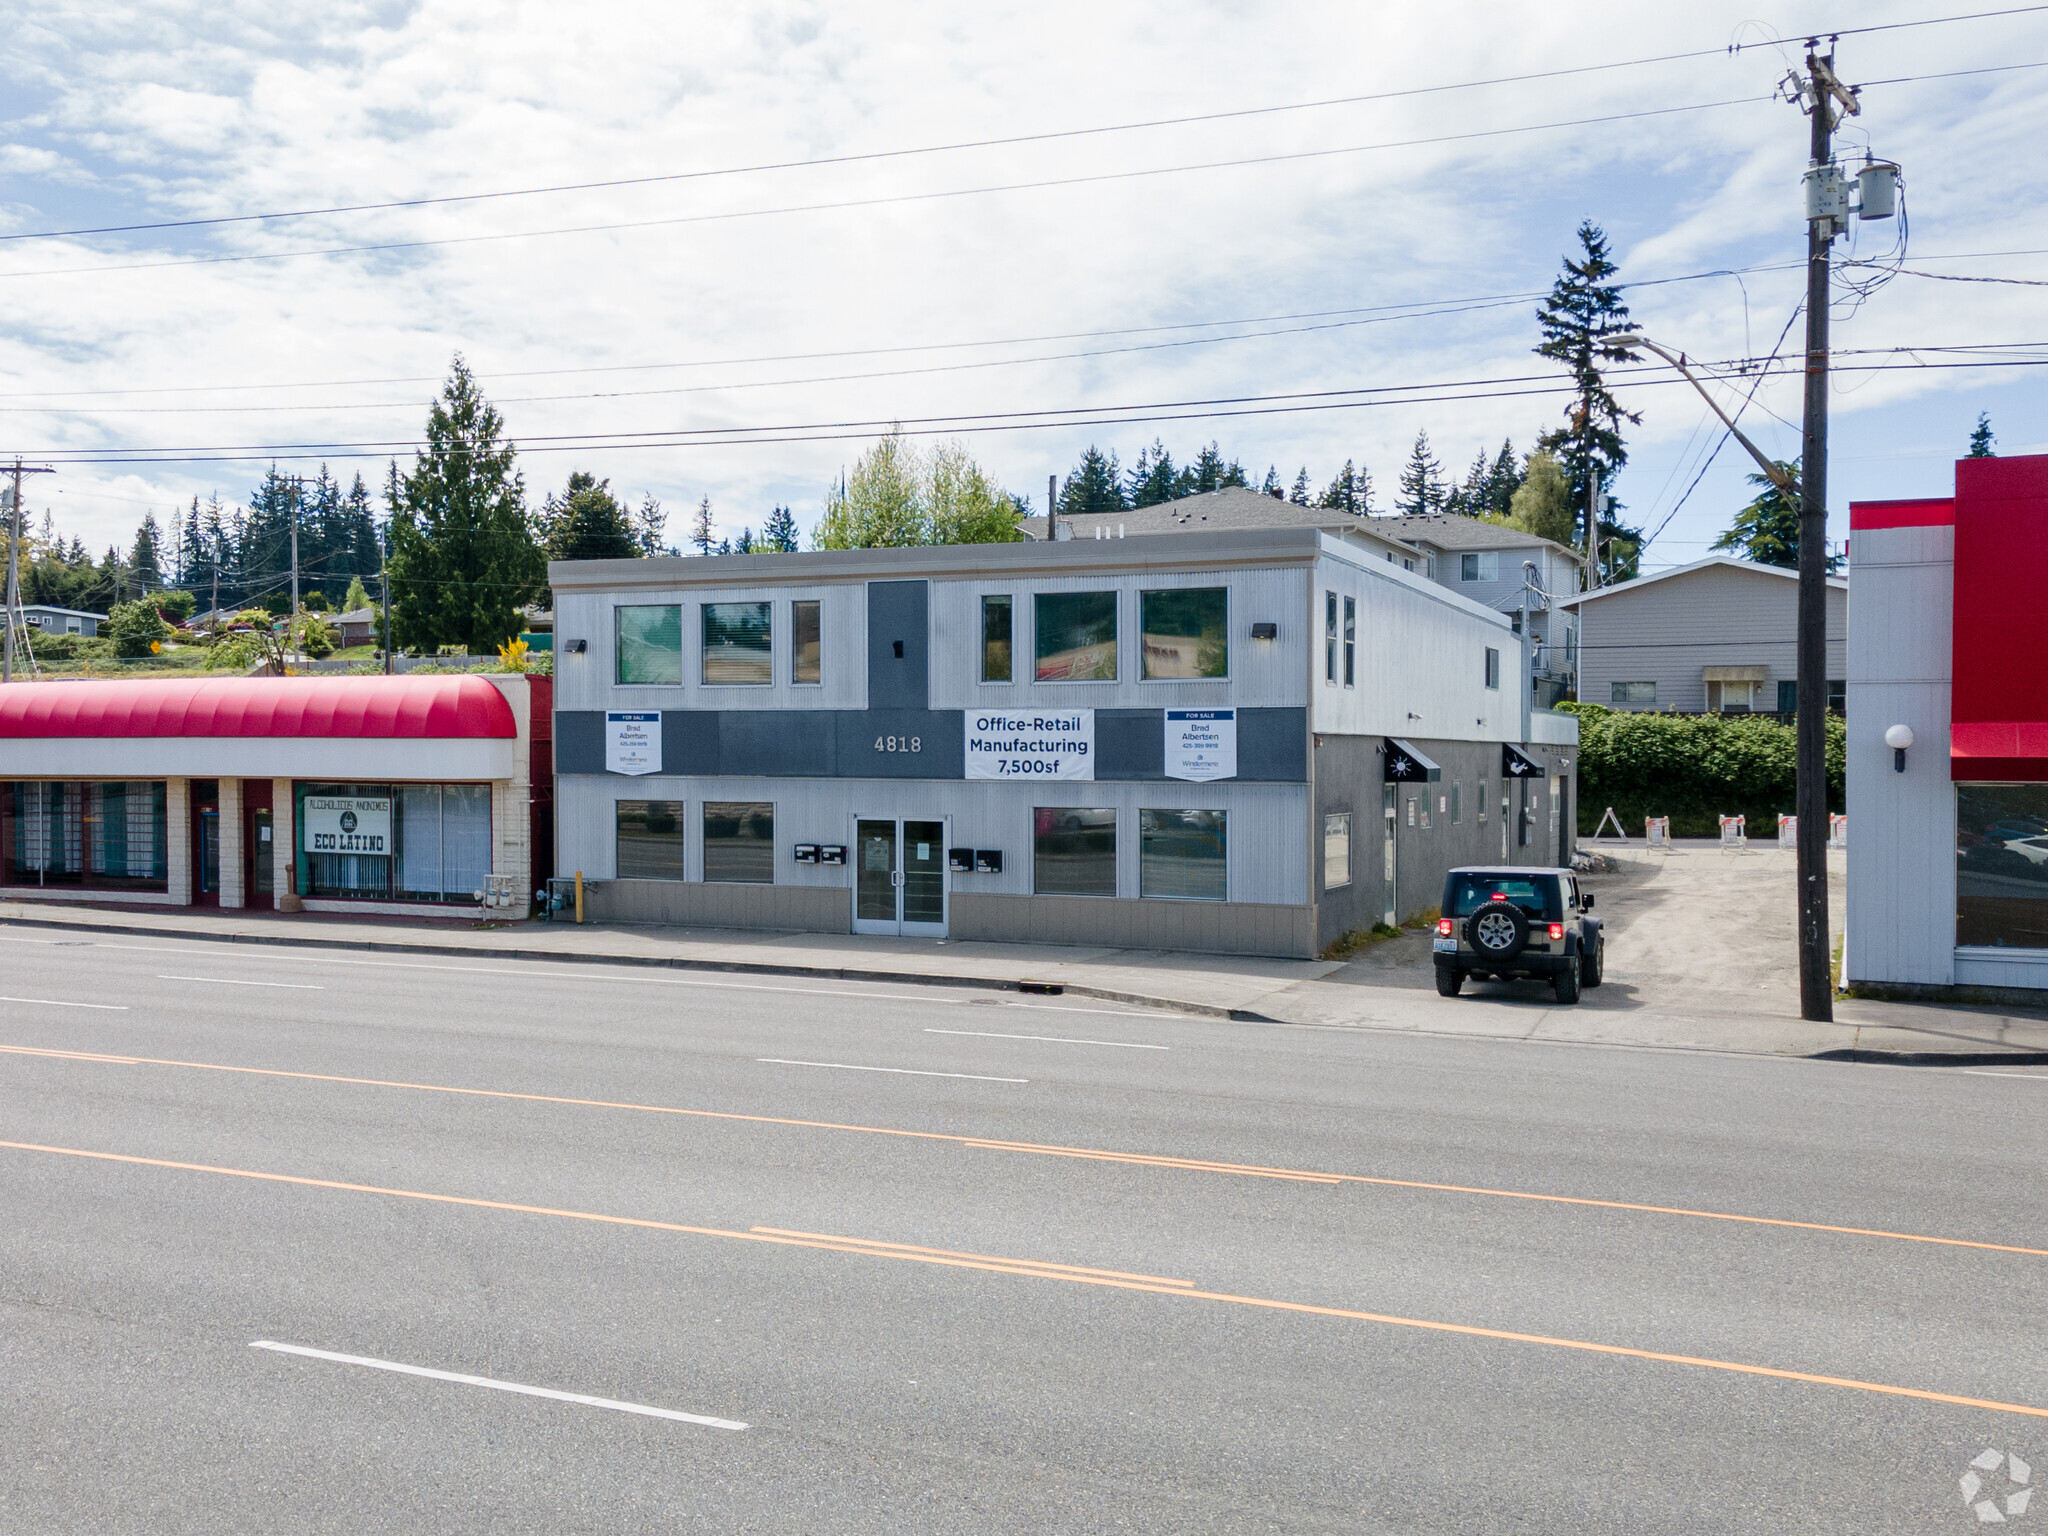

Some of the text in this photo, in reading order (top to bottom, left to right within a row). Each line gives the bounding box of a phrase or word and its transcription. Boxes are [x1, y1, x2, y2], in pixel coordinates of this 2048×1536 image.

[976, 717, 1081, 732] Office-Retail
[874, 735, 922, 753] 4818
[970, 738, 1088, 755] Manufacturing
[997, 760, 1060, 776] 7,500sf
[310, 799, 388, 812] ALCOHOLICOS ANONIMOS
[314, 833, 384, 851] ECO LATINO
